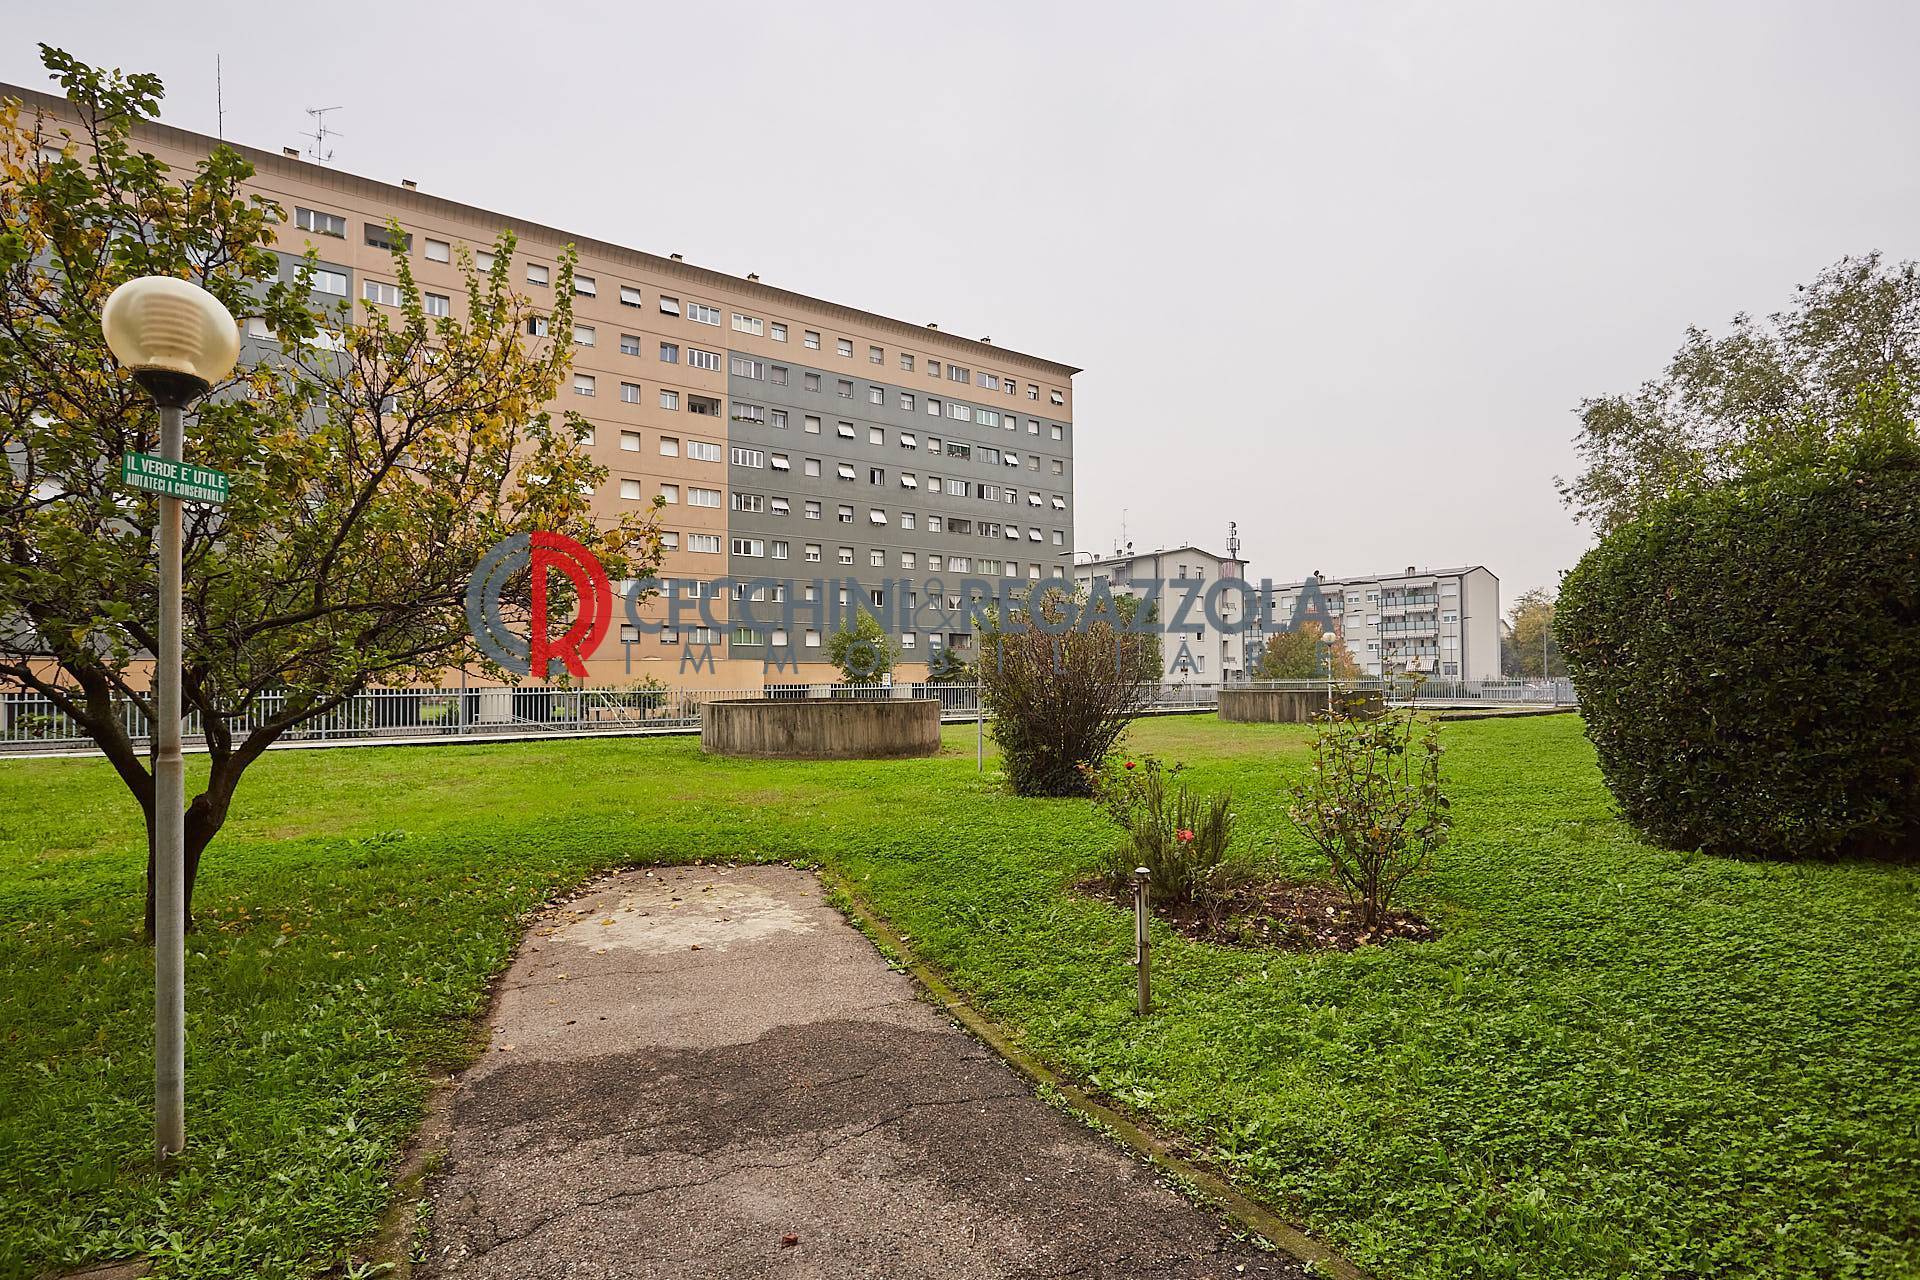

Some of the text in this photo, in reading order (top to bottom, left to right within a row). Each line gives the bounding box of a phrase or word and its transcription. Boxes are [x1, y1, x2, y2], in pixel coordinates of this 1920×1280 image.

[126, 455, 139, 471] IL
[141, 458, 178, 479] VERDE
[194, 470, 225, 489] UTILE
[126, 472, 225, 503] AIUTATECI A CONSERVARLO
